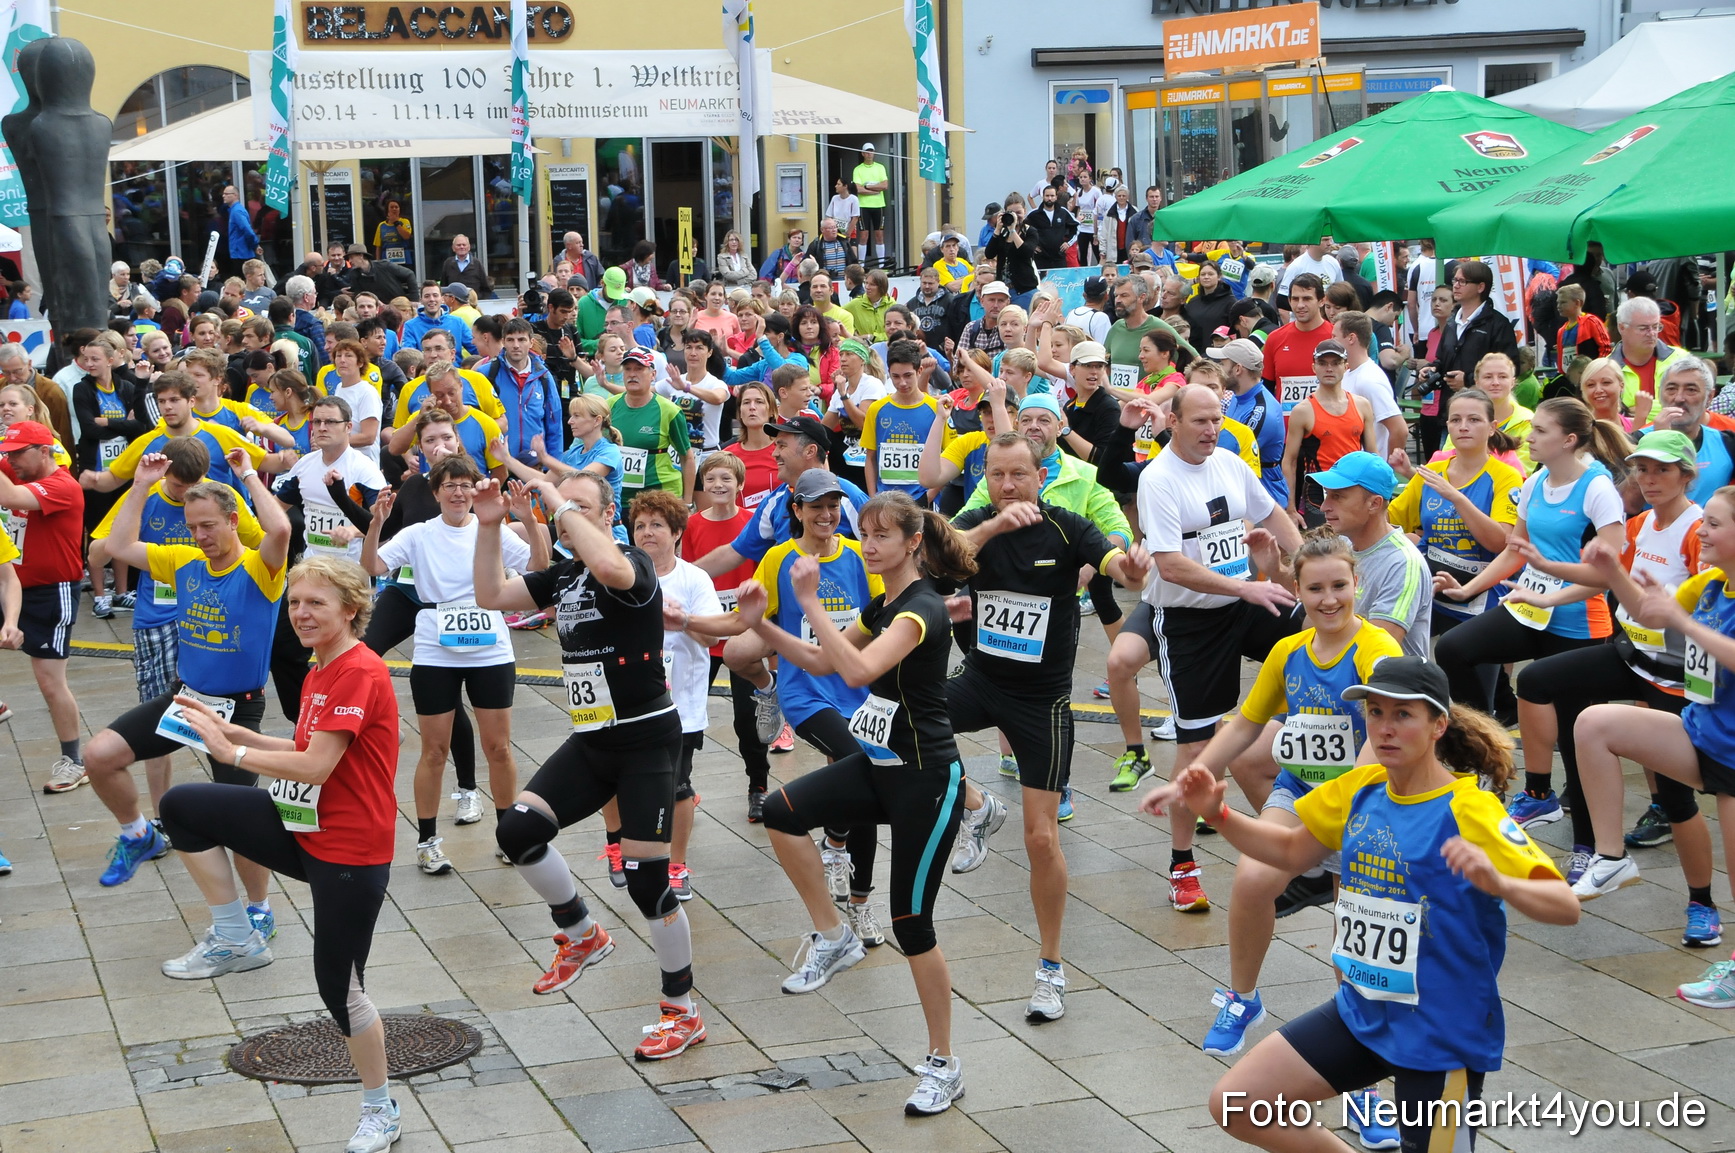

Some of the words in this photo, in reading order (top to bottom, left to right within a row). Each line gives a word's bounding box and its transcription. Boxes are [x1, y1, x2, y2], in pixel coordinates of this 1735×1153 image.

[307, 6, 571, 39] BELACCANTO
[1168, 20, 1310, 60] RUNMARKT.DE
[294, 67, 424, 94] usstellung
[443, 67, 487, 89] 100
[593, 66, 613, 88] 1.
[1404, 80, 1437, 91] WEBER
[1166, 89, 1221, 103] RUNMARKT.DE
[393, 102, 474, 120] 11.11.14
[487, 102, 508, 119] im
[528, 101, 648, 119] Stadtmuseum
[659, 97, 735, 111] NEUMARKT
[682, 228, 690, 260] A
[387, 250, 404, 259] 2443
[1222, 262, 1241, 275] 5151
[1112, 372, 1130, 387] 233
[883, 453, 920, 469] 5518
[1199, 532, 1218, 542] PARTL
[1428, 549, 1443, 561] PARTL
[1443, 555, 1470, 572] Neumarkt
[979, 593, 1001, 602] PARTL
[1002, 597, 1037, 609] Neumarkt
[444, 612, 492, 632] 2650
[830, 615, 856, 625] eumarkt
[983, 604, 1042, 636] 2447
[457, 636, 480, 645] Maria
[986, 634, 1028, 652] Bernhard
[852, 709, 887, 745] 2448
[1300, 721, 1336, 730] Neumarkt
[1280, 731, 1346, 762] 5133
[1300, 768, 1326, 780] Anna
[272, 778, 313, 804] 5132
[1387, 886, 1406, 896] 2014
[1338, 898, 1356, 912] PARTL
[1358, 905, 1400, 922] Neumarkt
[1341, 915, 1408, 966] 2379
[1348, 964, 1389, 988] Daniela
